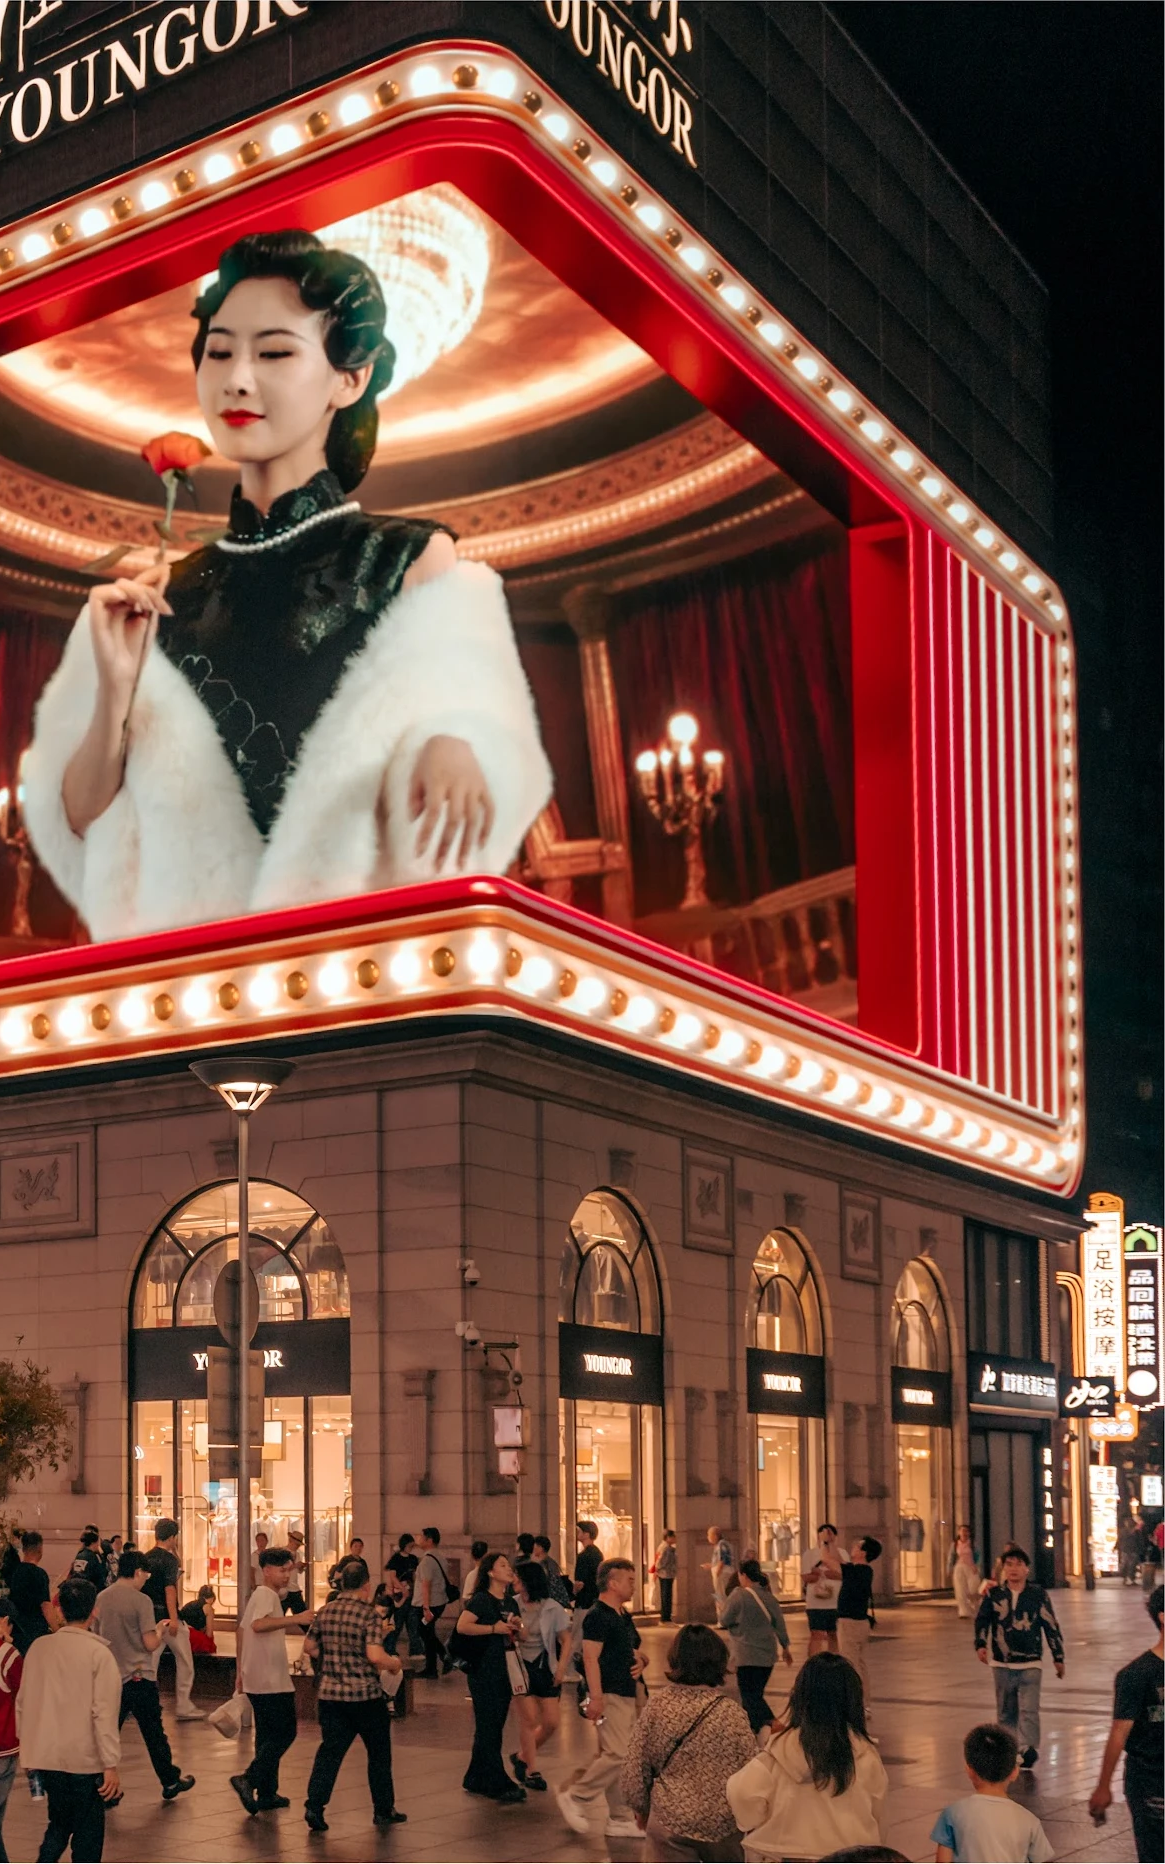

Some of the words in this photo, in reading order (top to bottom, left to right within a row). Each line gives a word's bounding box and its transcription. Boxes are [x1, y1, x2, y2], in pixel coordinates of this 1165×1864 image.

[1093, 1250, 1116, 1356] 足浴按摩
[584, 1353, 633, 1376] YOUNGOR
